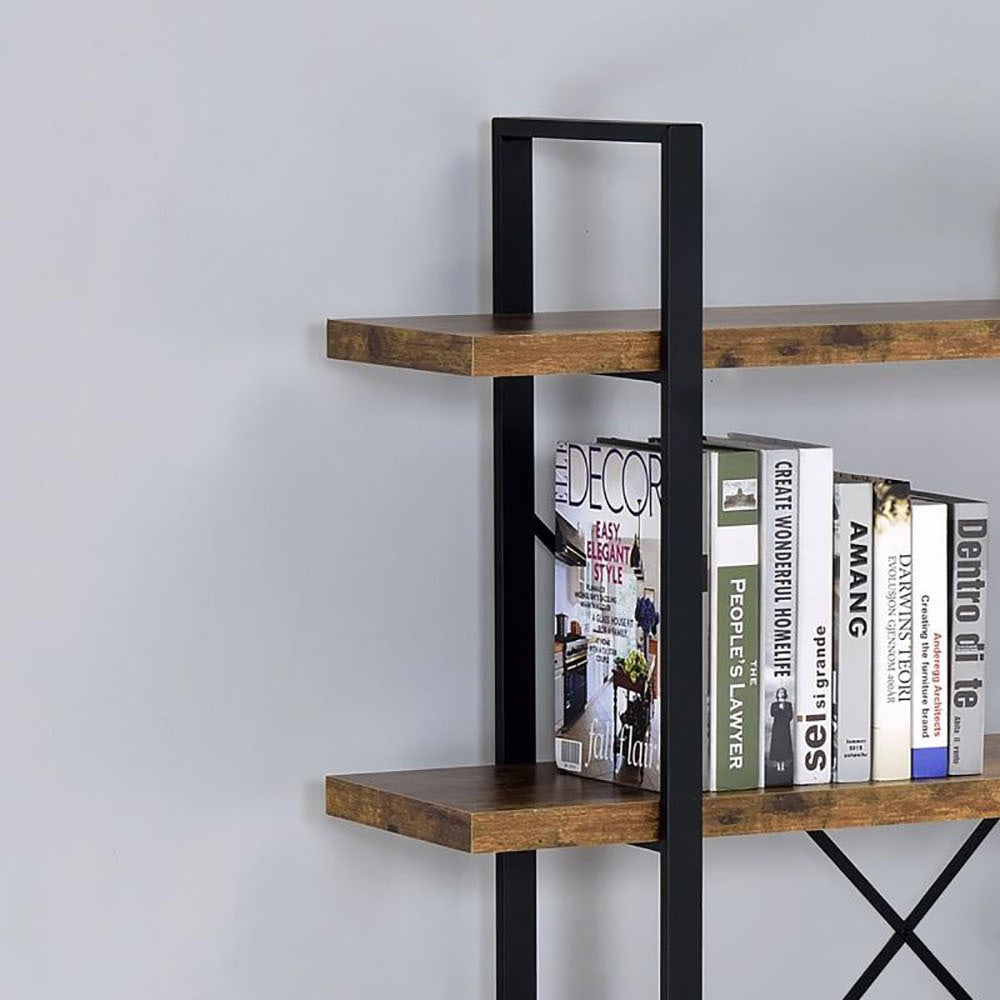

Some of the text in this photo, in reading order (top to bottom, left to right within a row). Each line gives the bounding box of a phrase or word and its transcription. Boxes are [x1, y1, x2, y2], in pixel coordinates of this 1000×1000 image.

[568, 444, 662, 517] DECOR
[587, 541, 631, 564] ELEGANT
[594, 563, 623, 585] STYLE
[595, 521, 621, 544] EASY,
[774, 461, 793, 677] CREATE WONDERFUL HOMELIFE
[849, 521, 868, 638] AMANG
[886, 555, 897, 616] EVOLUSJON
[954, 519, 988, 708] Dentro di te
[813, 625, 829, 688] grande
[898, 554, 912, 702] DARWINS TEORI
[920, 595, 930, 738] Creating the furniture brand
[729, 578, 746, 770] PEOPLE'S LAWYER
[813, 694, 826, 709] si
[932, 632, 942, 737] Anderegg Architects
